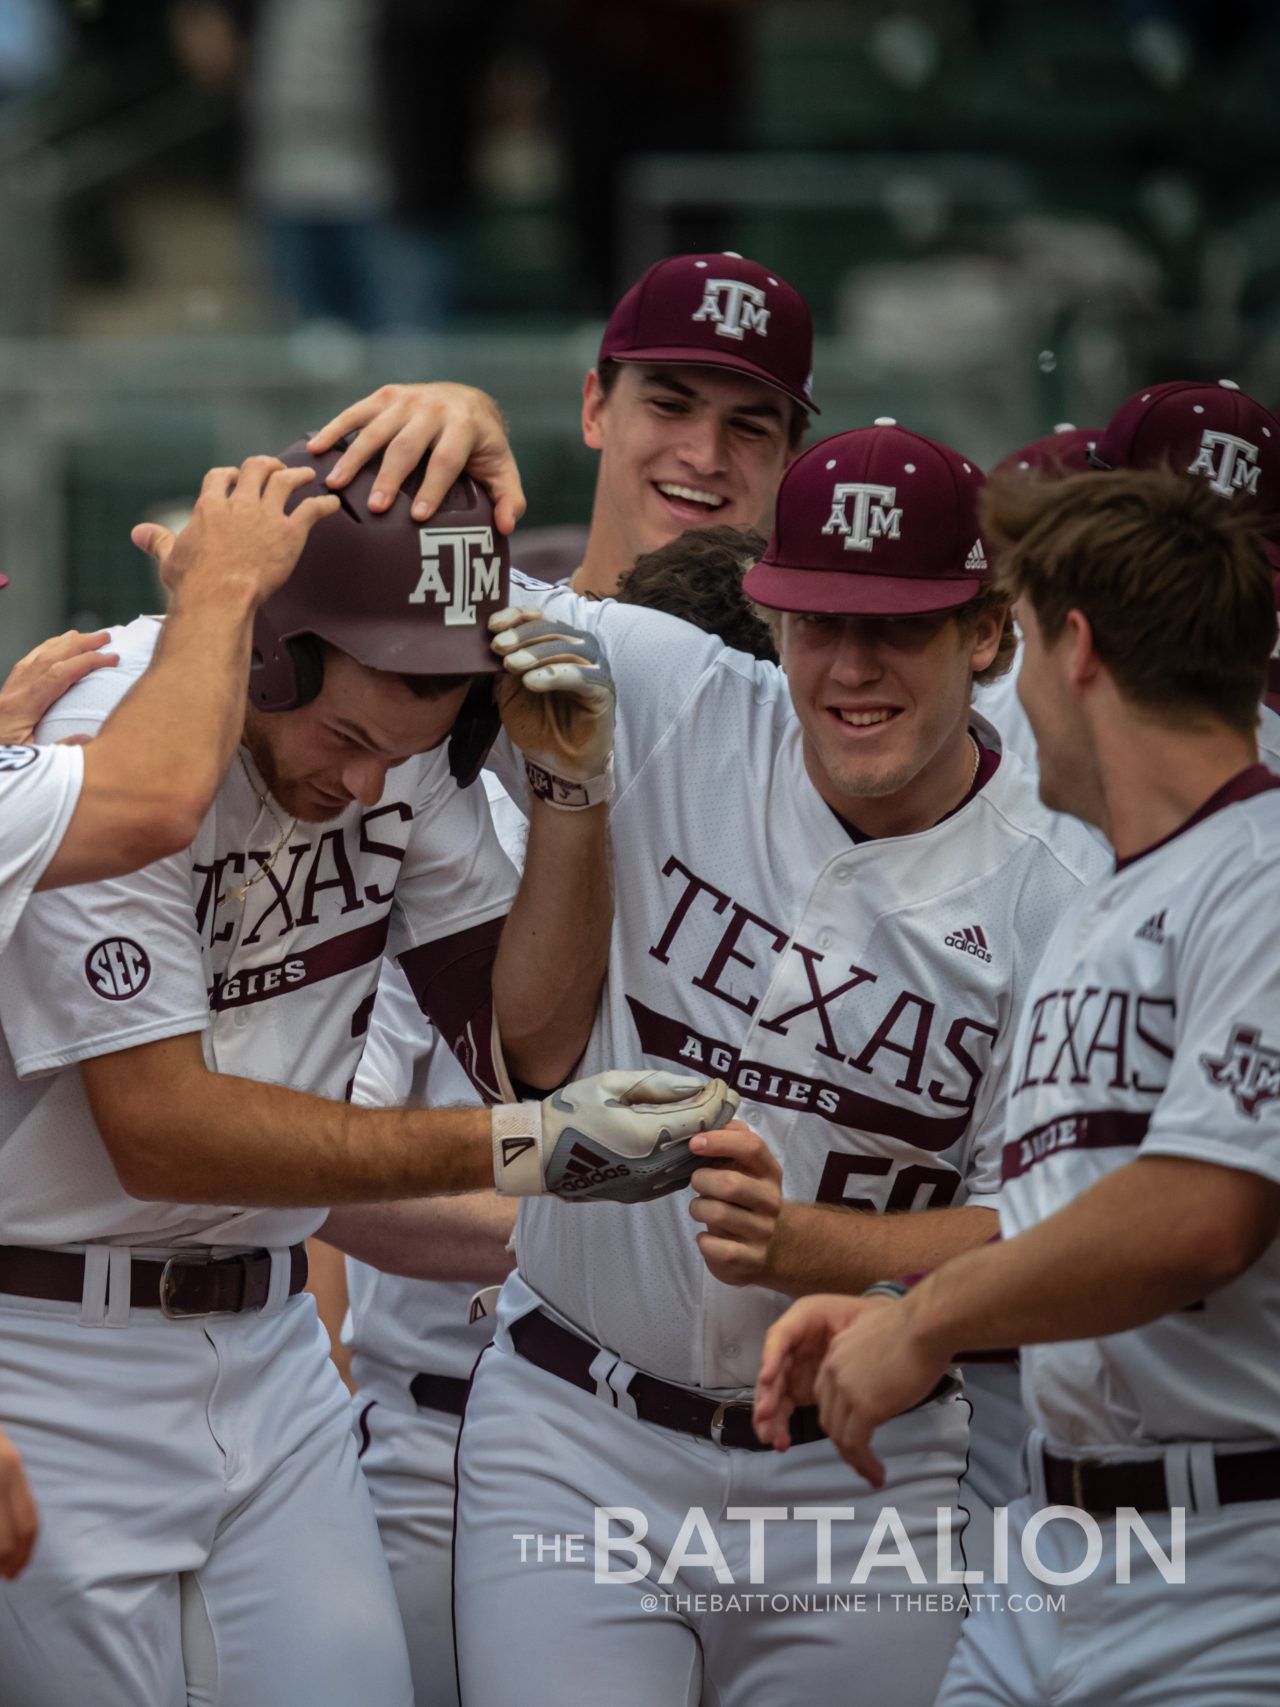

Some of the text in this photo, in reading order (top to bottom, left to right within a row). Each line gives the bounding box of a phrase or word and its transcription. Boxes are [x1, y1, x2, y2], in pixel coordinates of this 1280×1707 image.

[89, 940, 147, 997] SEC
[647, 855, 999, 1110] TEXAS
[943, 935, 993, 964] adidas
[679, 1034, 841, 1114] AGGIES
[1013, 986, 1177, 1098] EXAS
[561, 1163, 632, 1192] adidas
